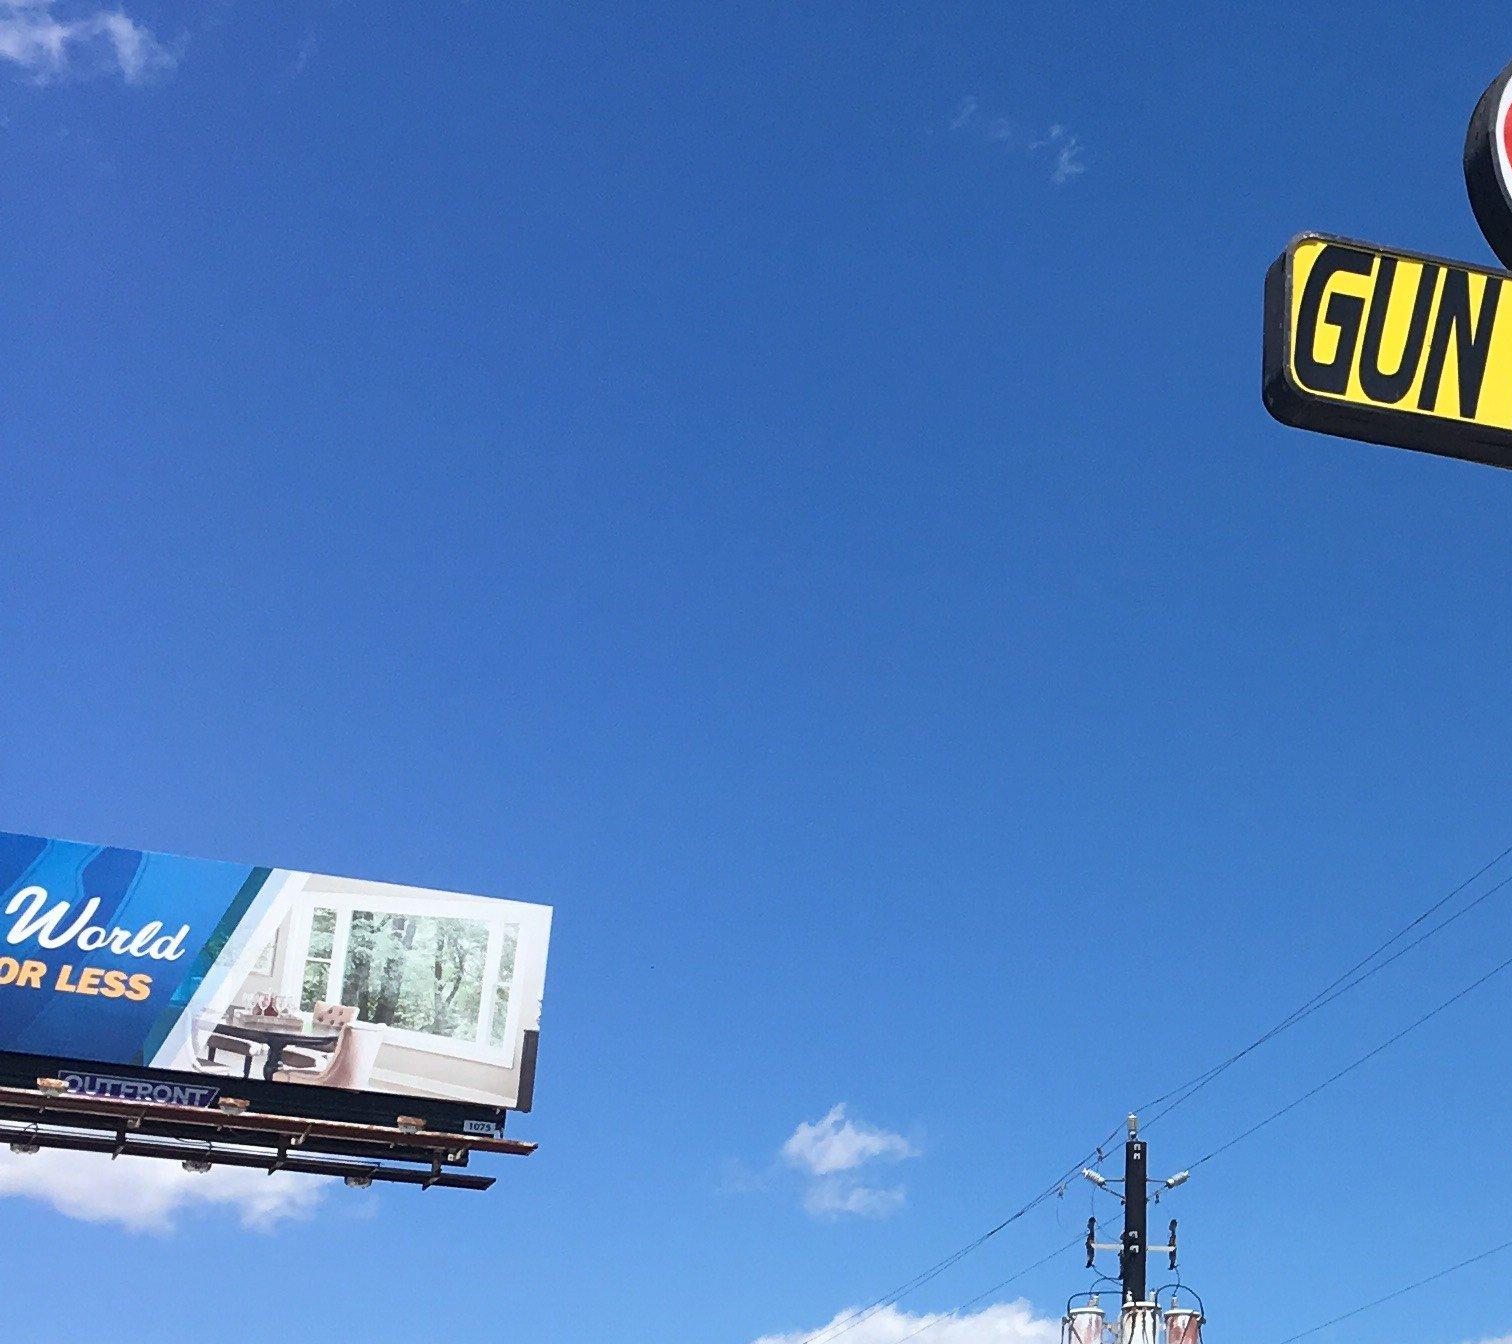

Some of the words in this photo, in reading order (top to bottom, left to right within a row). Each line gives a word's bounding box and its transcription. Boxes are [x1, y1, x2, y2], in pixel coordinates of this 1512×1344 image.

[1293, 244, 1503, 419] GUN
[5, 886, 190, 961] World
[55, 964, 153, 1001] LESS
[64, 1074, 209, 1106] OUTFRONT
